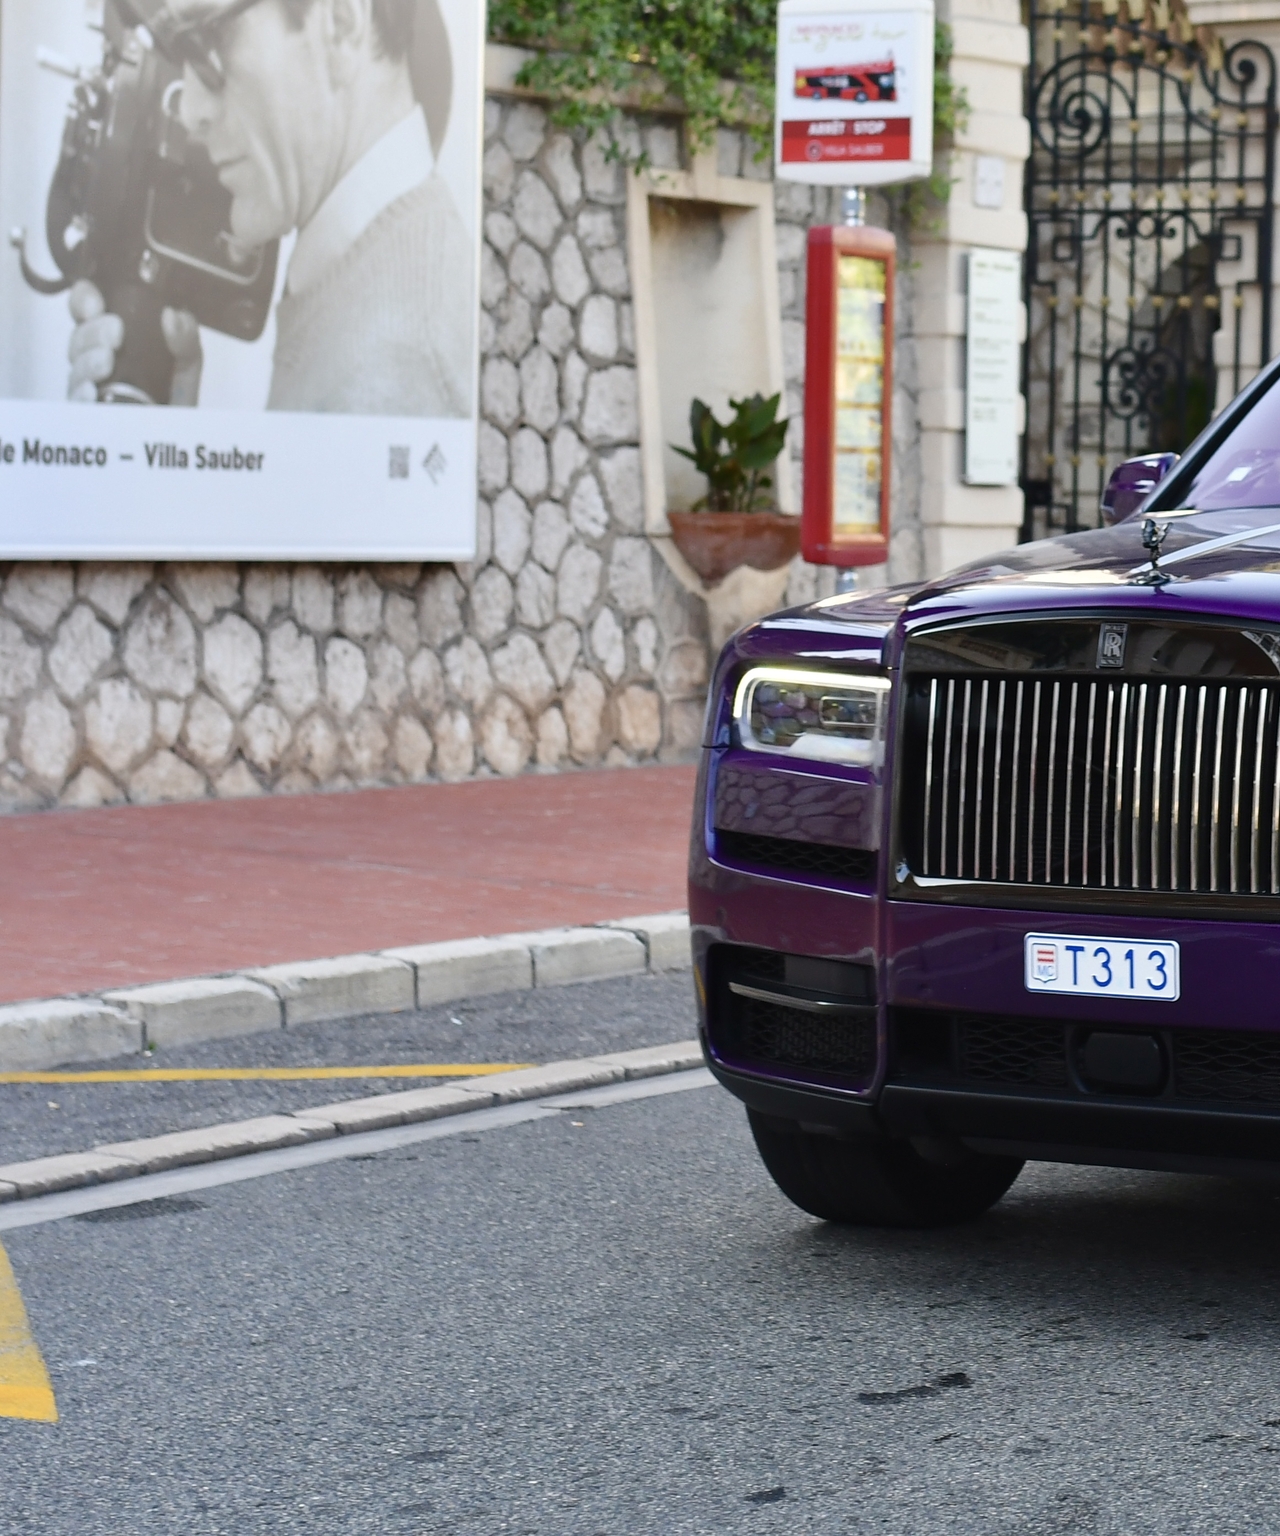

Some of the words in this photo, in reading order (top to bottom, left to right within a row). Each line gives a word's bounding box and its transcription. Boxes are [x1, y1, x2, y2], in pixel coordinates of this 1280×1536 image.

[854, 120, 886, 135] STOP
[23, 438, 108, 467] Monaco
[144, 443, 190, 470] Villa
[195, 446, 265, 472] Sauber
[1065, 945, 1168, 990] T313
